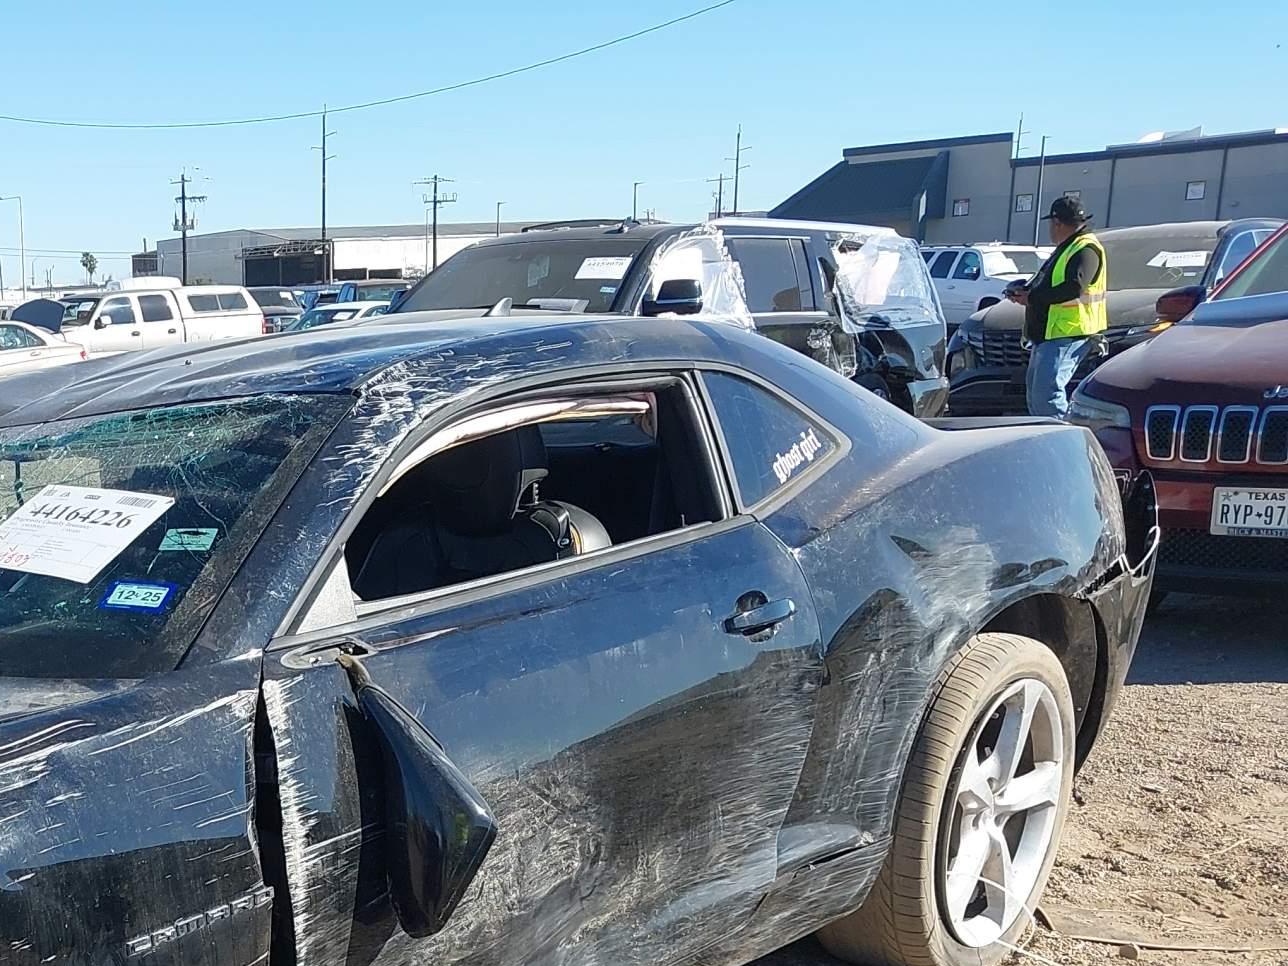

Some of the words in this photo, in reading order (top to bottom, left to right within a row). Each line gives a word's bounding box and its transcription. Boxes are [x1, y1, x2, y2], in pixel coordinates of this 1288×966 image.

[773, 442, 805, 484] ghost
[799, 427, 822, 462] girl
[1248, 491, 1286, 501] TEXAS
[31, 503, 138, 529] 44164226
[116, 590, 136, 601] 12
[140, 591, 163, 602] 25
